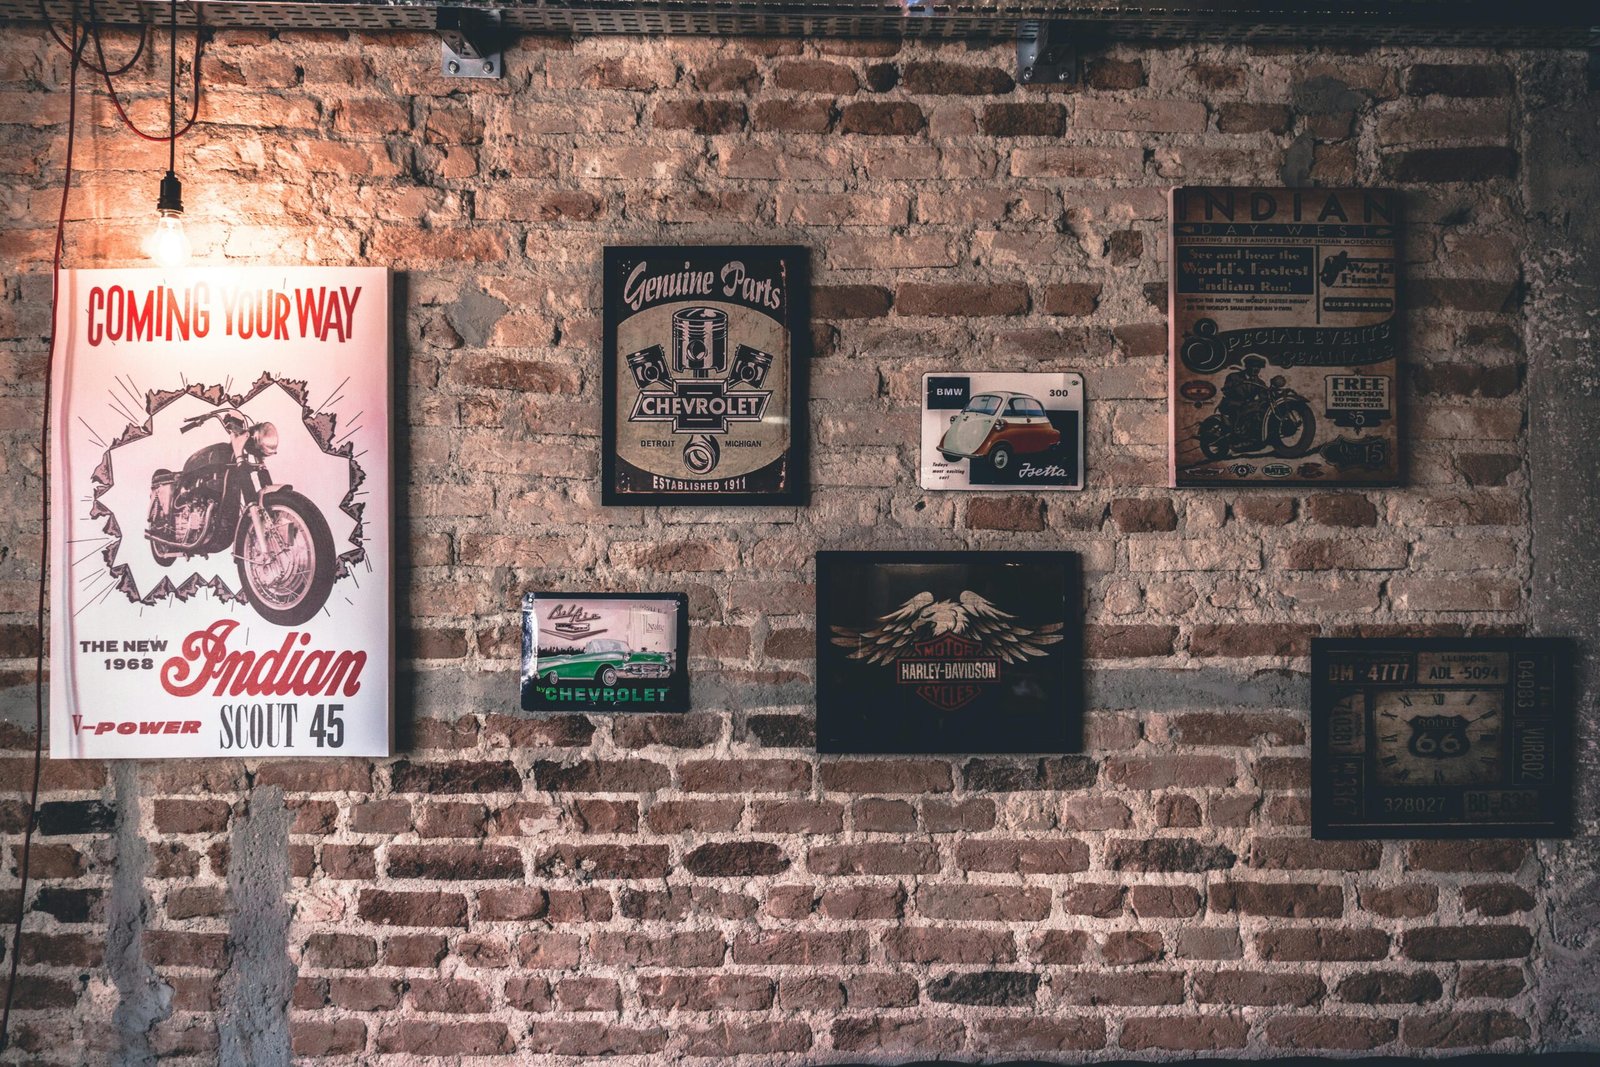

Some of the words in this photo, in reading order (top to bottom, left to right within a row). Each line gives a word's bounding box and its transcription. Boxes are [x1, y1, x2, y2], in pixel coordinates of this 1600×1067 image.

[1178, 190, 1393, 223] INDIAN
[1201, 224, 1258, 235] DAY
[1189, 248, 1213, 260] See
[1216, 249, 1241, 260] and
[1245, 249, 1275, 260] hear
[1279, 249, 1300, 260] the
[1183, 262, 1245, 275] World's
[1250, 262, 1308, 276] Fastest
[1345, 263, 1394, 273] World
[623, 260, 714, 311] Genuine
[720, 260, 781, 310] Parts
[1198, 277, 1255, 291] Indian
[1341, 273, 1389, 284] Finals
[87, 281, 210, 347] COMING
[221, 287, 290, 341] YOUR
[294, 286, 362, 343] WAY
[1332, 377, 1384, 390] FREE
[936, 388, 963, 396] BMW
[1049, 389, 1068, 397] 300
[642, 398, 759, 415] CHEVROLET
[640, 439, 676, 448] DETROIT
[725, 440, 762, 448] MICHIGAN
[1018, 462, 1068, 478] Isetta
[652, 475, 720, 491] ESTABLISHED
[724, 477, 747, 490] 1911
[79, 640, 118, 653] THE
[123, 640, 168, 652] NEW
[924, 638, 975, 656] MOTOR
[104, 658, 154, 671] 1968
[160, 619, 367, 698] Indian
[901, 662, 997, 680] HARLEY-DAVIDSON
[1367, 663, 1410, 681] 4777
[536, 685, 545, 693] by
[545, 687, 671, 702] CHEVROLET
[923, 685, 974, 706] CYCLES
[72, 714, 203, 737] V-POWER
[219, 703, 298, 749] SCOUT
[309, 704, 344, 748] 45
[1418, 719, 1460, 728] ROUTE
[1415, 732, 1461, 753] 66
[1384, 797, 1446, 813] 328027
